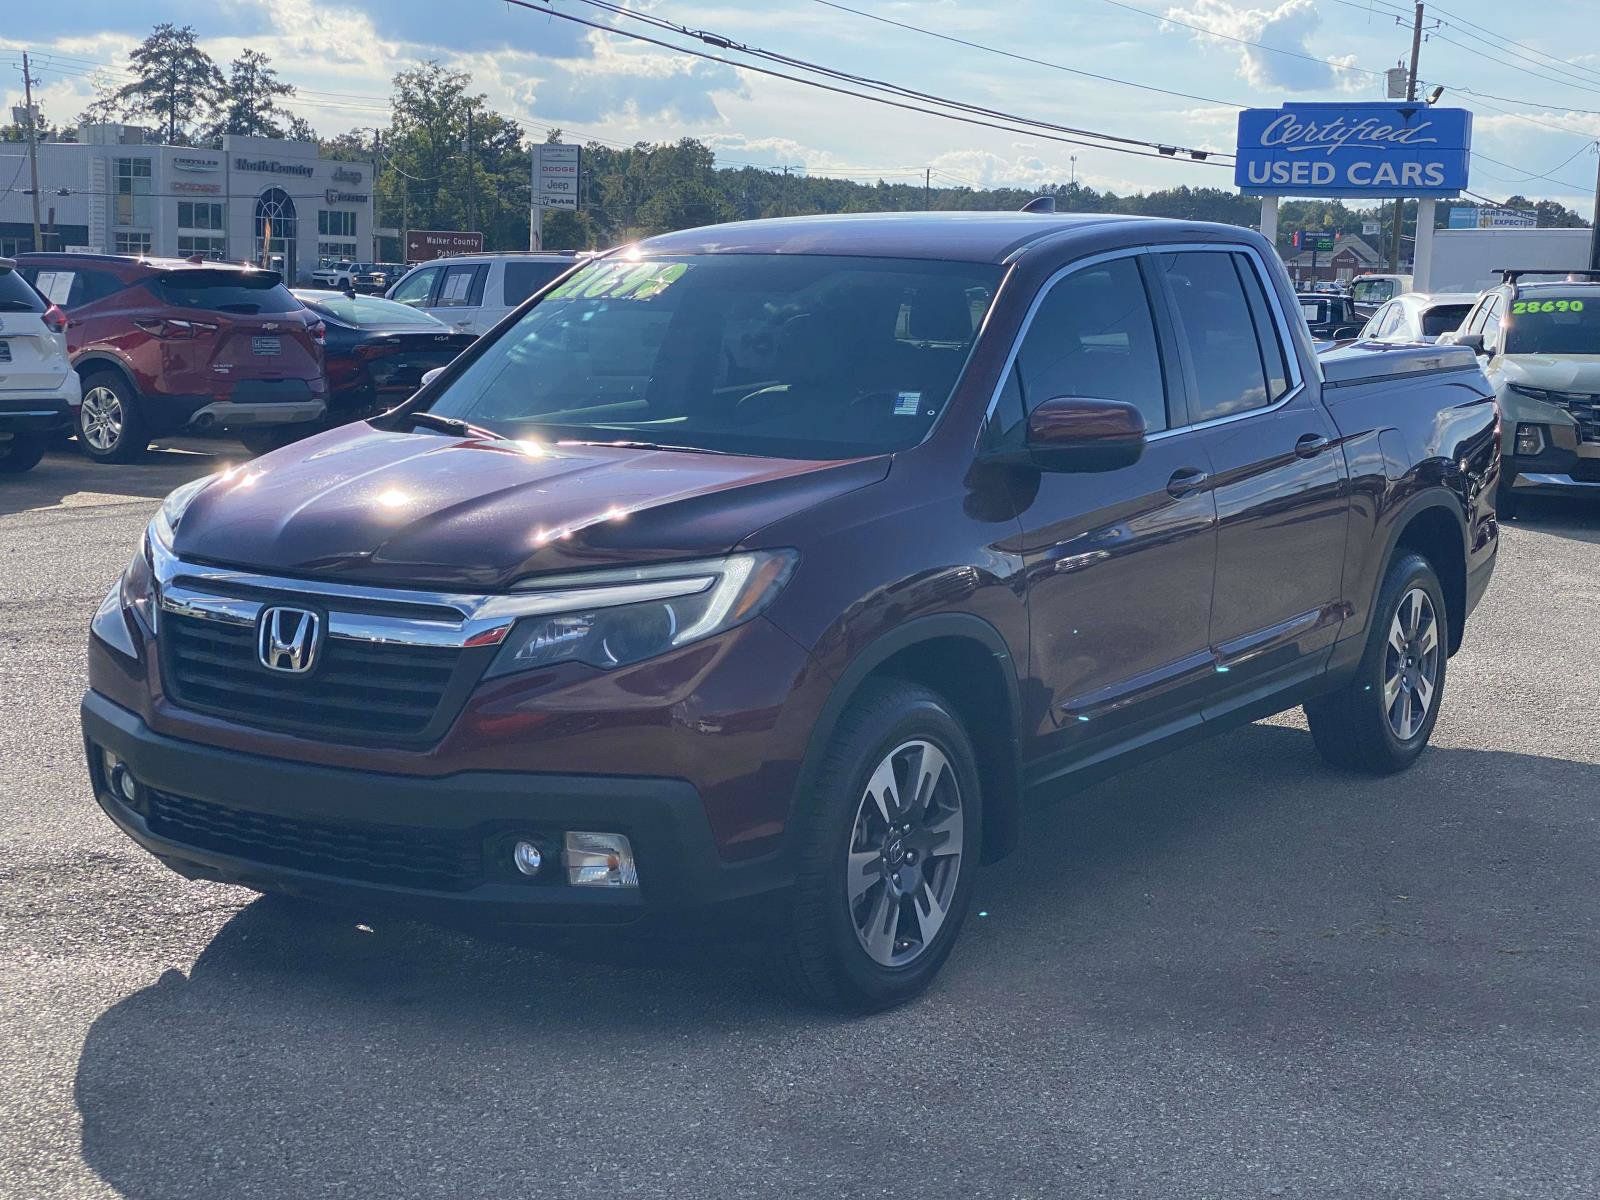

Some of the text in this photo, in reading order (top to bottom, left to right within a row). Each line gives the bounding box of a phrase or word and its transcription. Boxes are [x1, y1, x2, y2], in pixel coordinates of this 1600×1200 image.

[1261, 114, 1437, 155] Certified
[1249, 161, 1445, 186] USED CARS
[547, 180, 569, 191] Jeep
[426, 236, 479, 248] Walker County
[1512, 301, 1584, 314] 28690
